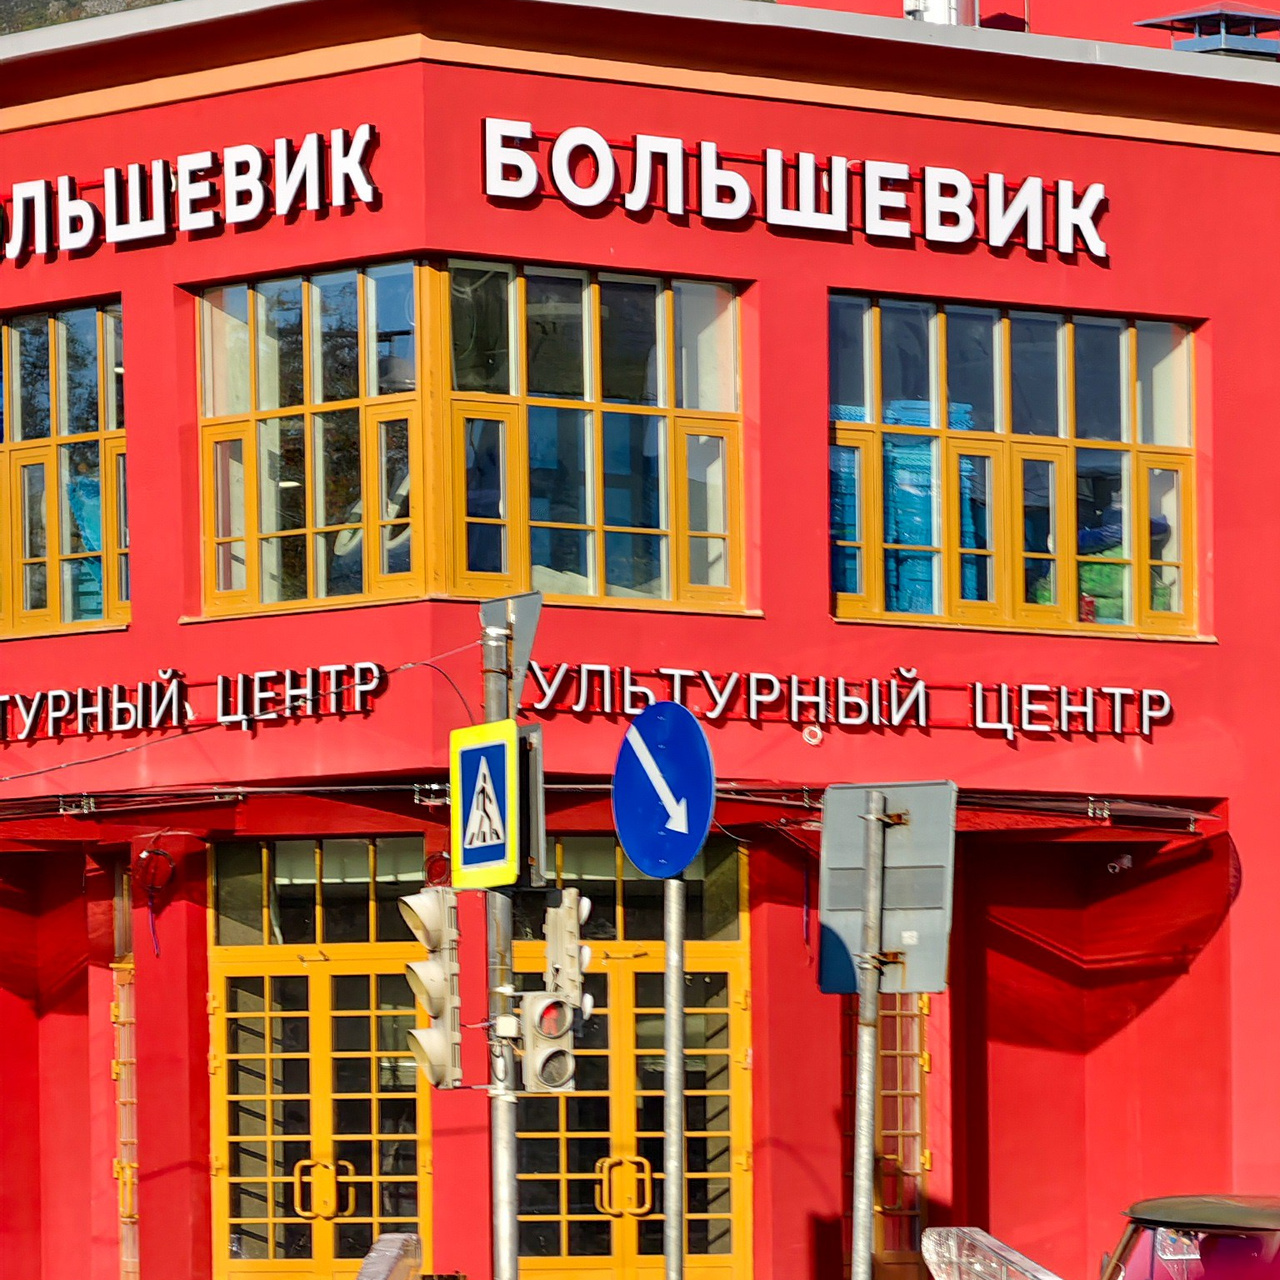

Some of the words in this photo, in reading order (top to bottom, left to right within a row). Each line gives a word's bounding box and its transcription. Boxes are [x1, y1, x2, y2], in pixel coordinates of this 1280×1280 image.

[0, 123, 376, 259] ЛЬШЕВИК
[484, 117, 1108, 258] БОЛЬШЕВИК
[216, 661, 381, 731] ЦЕНТР
[518, 660, 927, 728] УЛЬТУРНЫЙ
[975, 681, 1171, 740] ЦЕНТР
